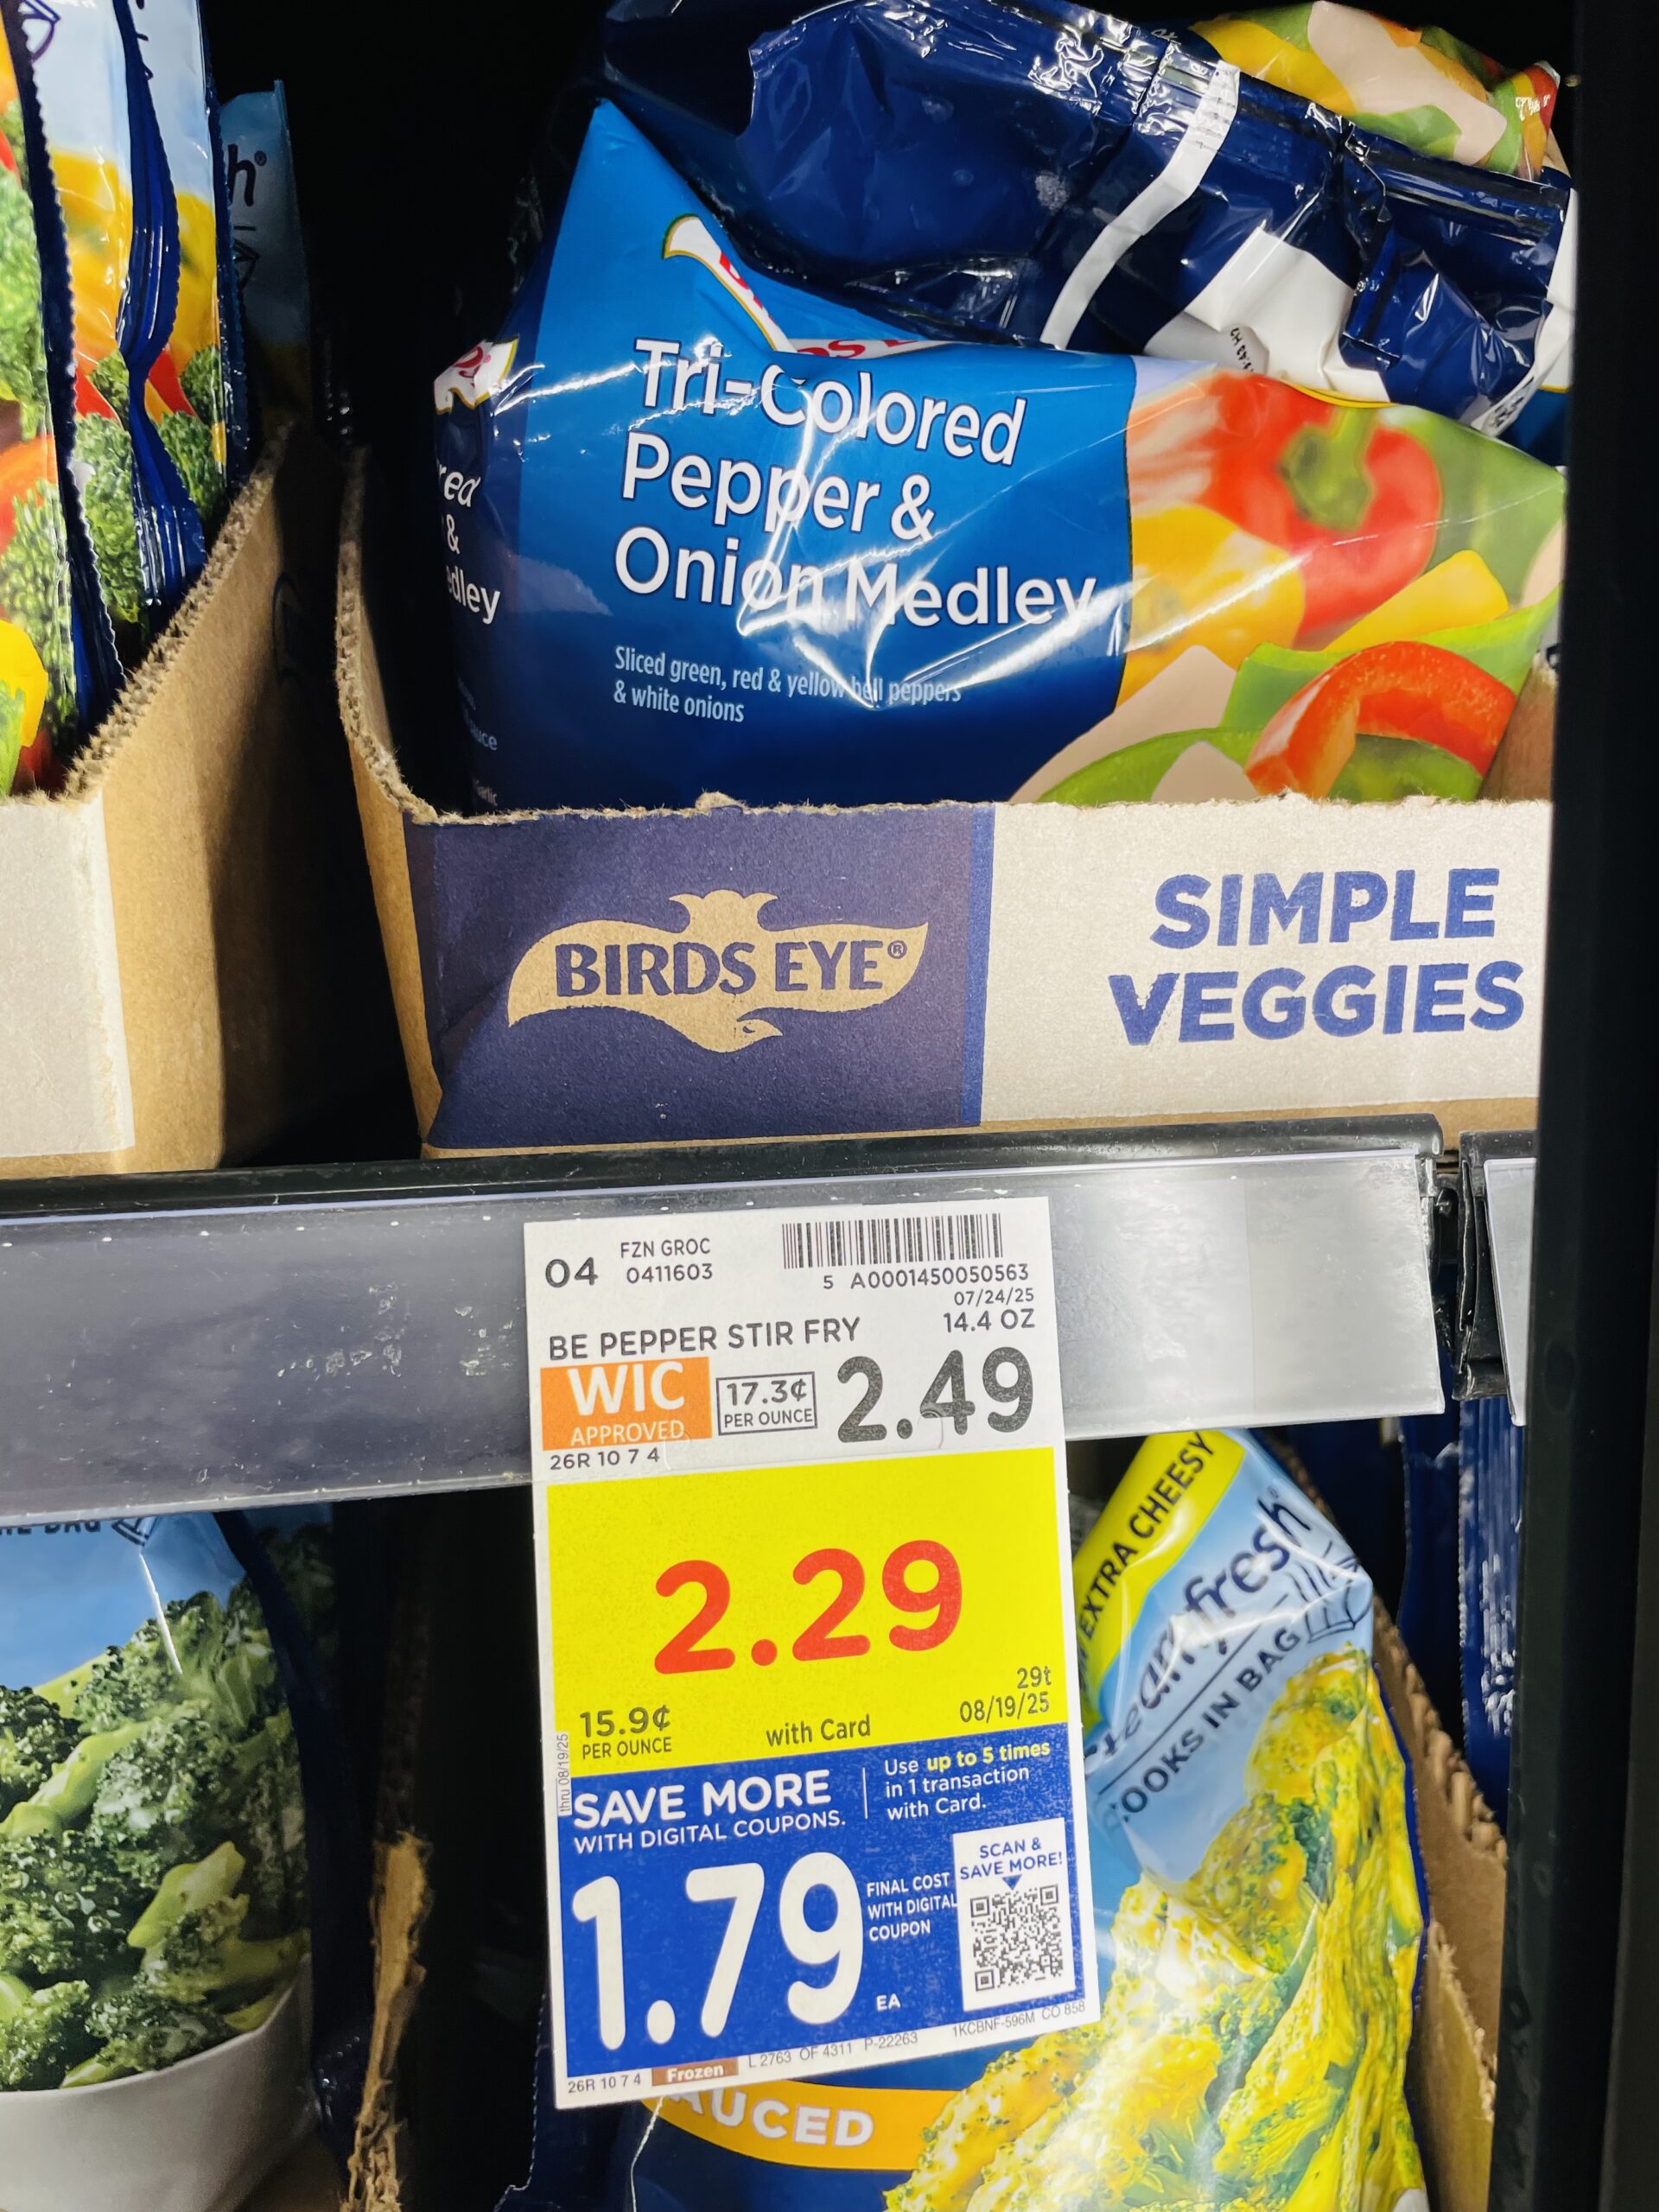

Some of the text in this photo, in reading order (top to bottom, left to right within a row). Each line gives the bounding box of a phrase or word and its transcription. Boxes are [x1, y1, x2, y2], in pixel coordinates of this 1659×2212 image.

[634, 337, 1027, 467] Tri-Colored
[620, 430, 936, 541] Pepper &
[614, 524, 1097, 632] Onion Medley
[614, 645, 665, 678] Sliced
[670, 660, 727, 690] green,
[732, 667, 763, 691] red
[768, 669, 782, 693] &
[787, 671, 844, 698] yellow
[888, 682, 963, 704] peppers
[613, 679, 745, 724] & white onions
[1149, 868, 1500, 950] SIMPLE
[555, 942, 755, 996] BIRDS
[1108, 960, 1524, 1046] VEGGIES
[620, 1237, 711, 1258] FZN GROC
[545, 1257, 599, 1288] 04
[626, 1263, 713, 1284] 0411603
[823, 1263, 1029, 1289] 5 A0001450050563
[954, 1287, 1034, 1306] 07/24/25
[943, 1308, 1035, 1332] 14.4 OZ
[549, 1316, 861, 1361] BE PEPPER STIR FRY
[566, 1361, 685, 1416] WIC
[836, 1346, 1034, 1445] 2.49
[570, 1420, 685, 1446] APPROVED
[724, 1408, 813, 1428] PER OUNCE
[550, 1447, 660, 1471] 26R 10 7 4
[1080, 1433, 1214, 1640] EXTRA CHEESY
[653, 1539, 964, 1676] 2.29
[1202, 1692, 1240, 1729] IN
[1236, 1627, 1300, 1692] BAG
[959, 1691, 1051, 1725] 08/19/25
[766, 1714, 872, 1747] with Card
[582, 1736, 672, 1760] PER OUNCE
[884, 1741, 1051, 1777] Use up to 5 times
[556, 1733, 572, 1814] thru 08/19/25
[886, 1765, 1030, 1798] in 1 transaction
[574, 1769, 832, 1830] SAVE MORE
[887, 1792, 987, 1821] with Card.
[574, 1810, 846, 1854] WITH DIGITAL COUPONS.
[979, 1837, 1042, 1859] SCAN &
[960, 1852, 1063, 1880] SAVE MORE!
[866, 1872, 950, 1897] FINAL COST
[867, 1893, 958, 1920] WITH DIGITAL
[868, 1918, 931, 1942] COUPON
[572, 1851, 864, 2050] 1.79
[876, 1993, 900, 2012] EA
[1041, 2005, 1061, 2020] CO
[1065, 2000, 1085, 2015] 858
[748, 2031, 918, 2069] L 2763 OF 4311 P-22263
[568, 2073, 641, 2093] 26R 10 7 4
[667, 2063, 724, 2083] Frozen
